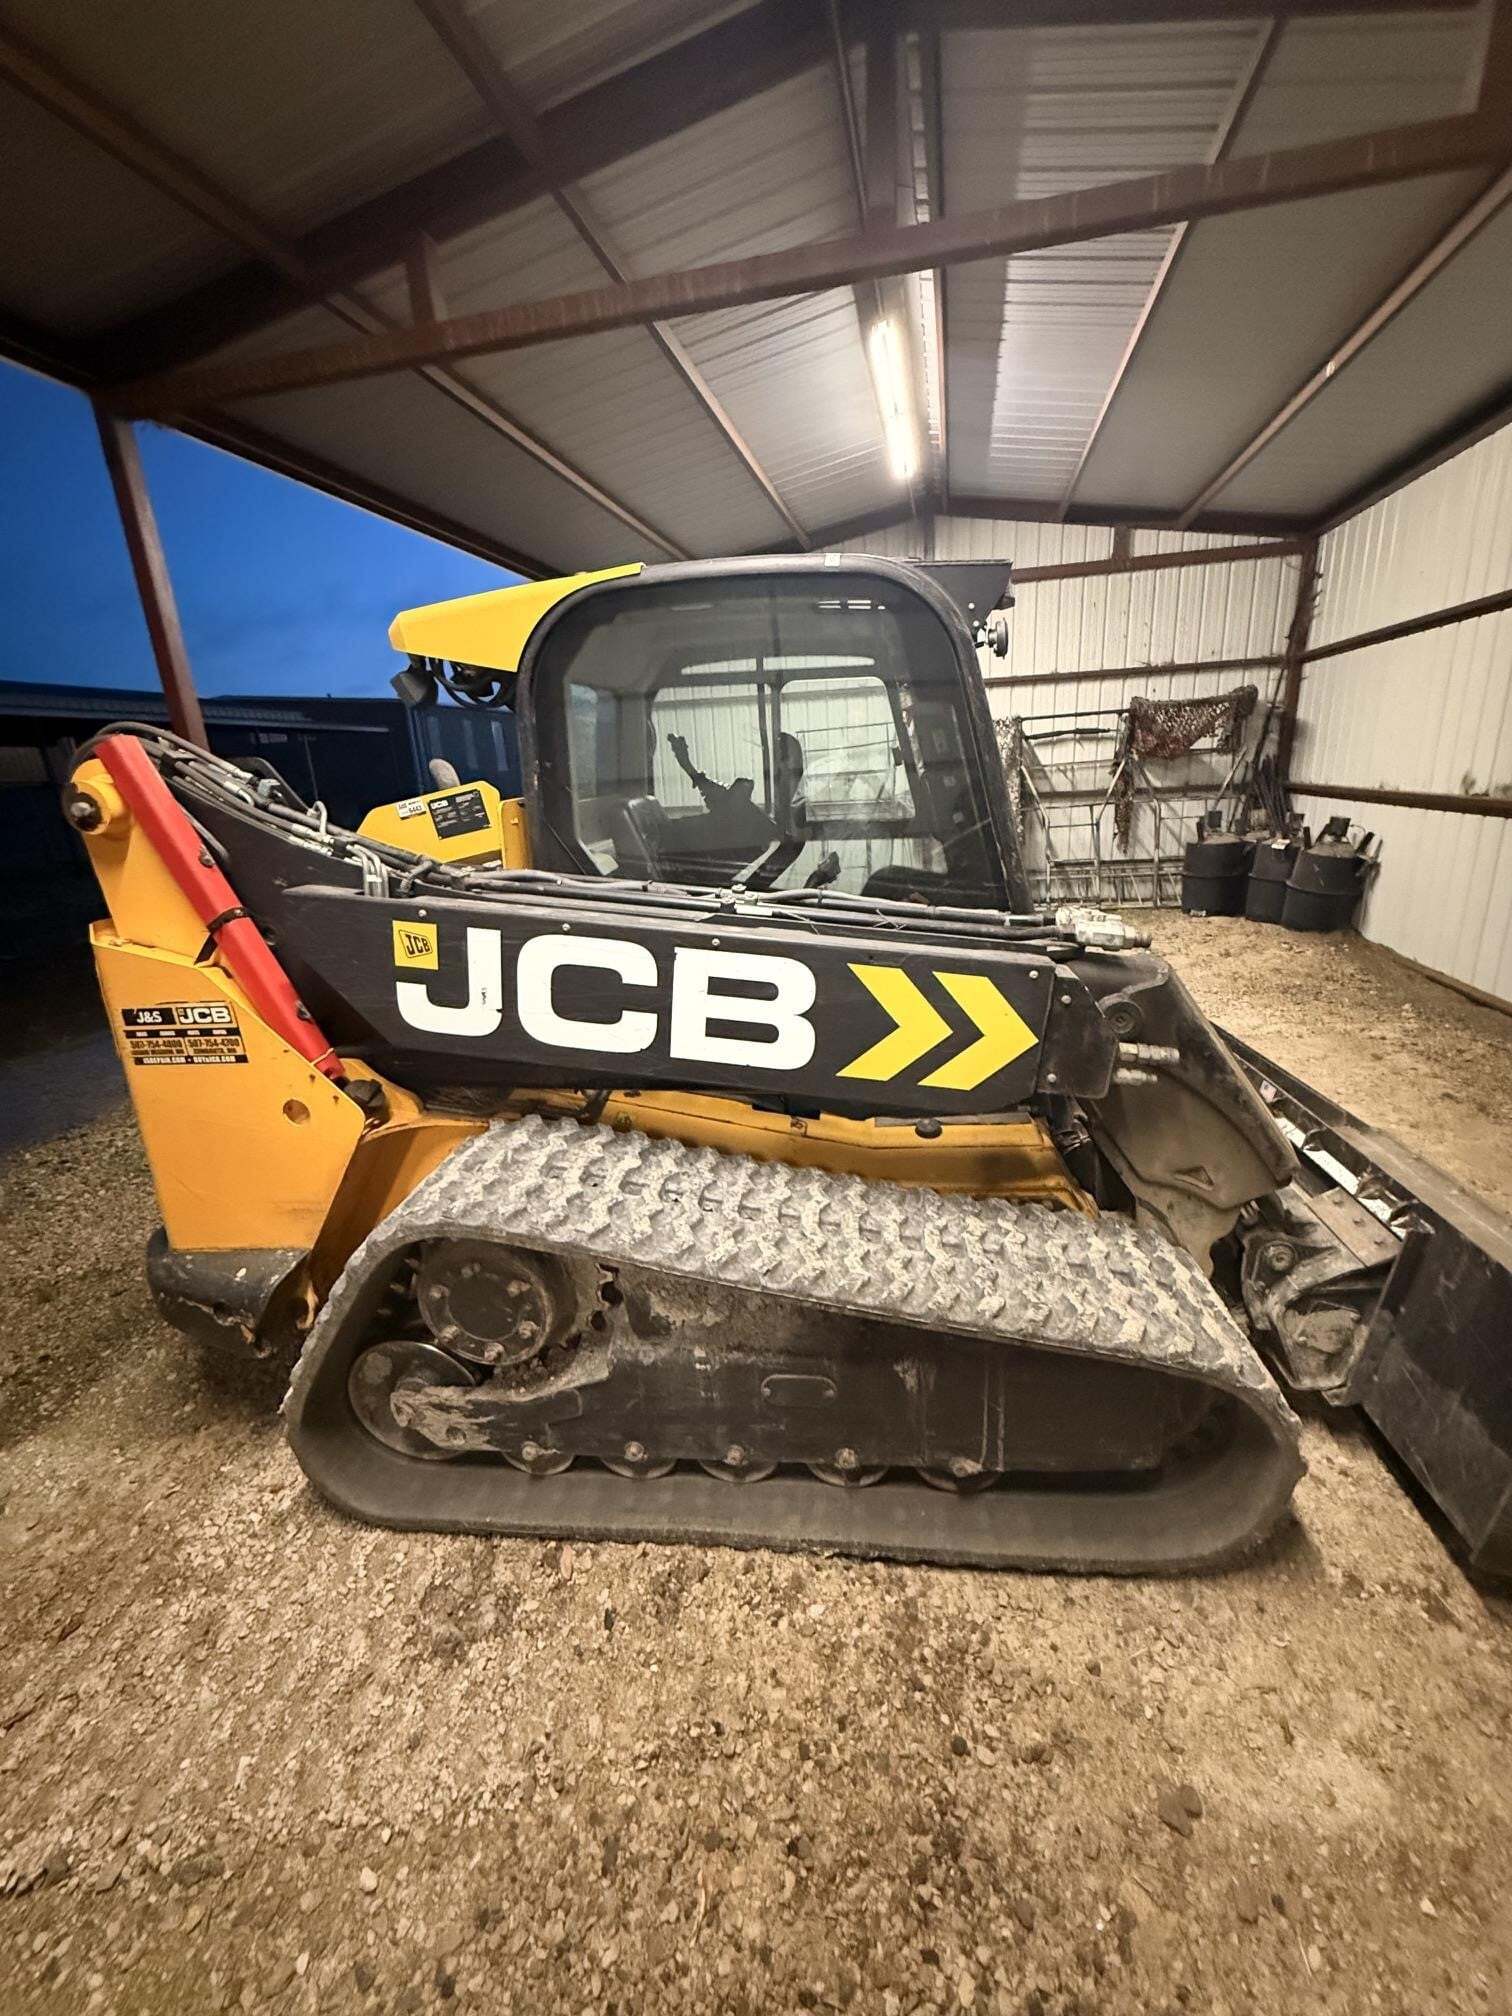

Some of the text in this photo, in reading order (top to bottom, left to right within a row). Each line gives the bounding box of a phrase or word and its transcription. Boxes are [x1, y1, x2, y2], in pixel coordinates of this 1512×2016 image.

[404, 933, 432, 955] JCB
[396, 927, 816, 1071] JCB
[136, 1011, 163, 1023] J&S
[179, 1007, 231, 1024] JCB
